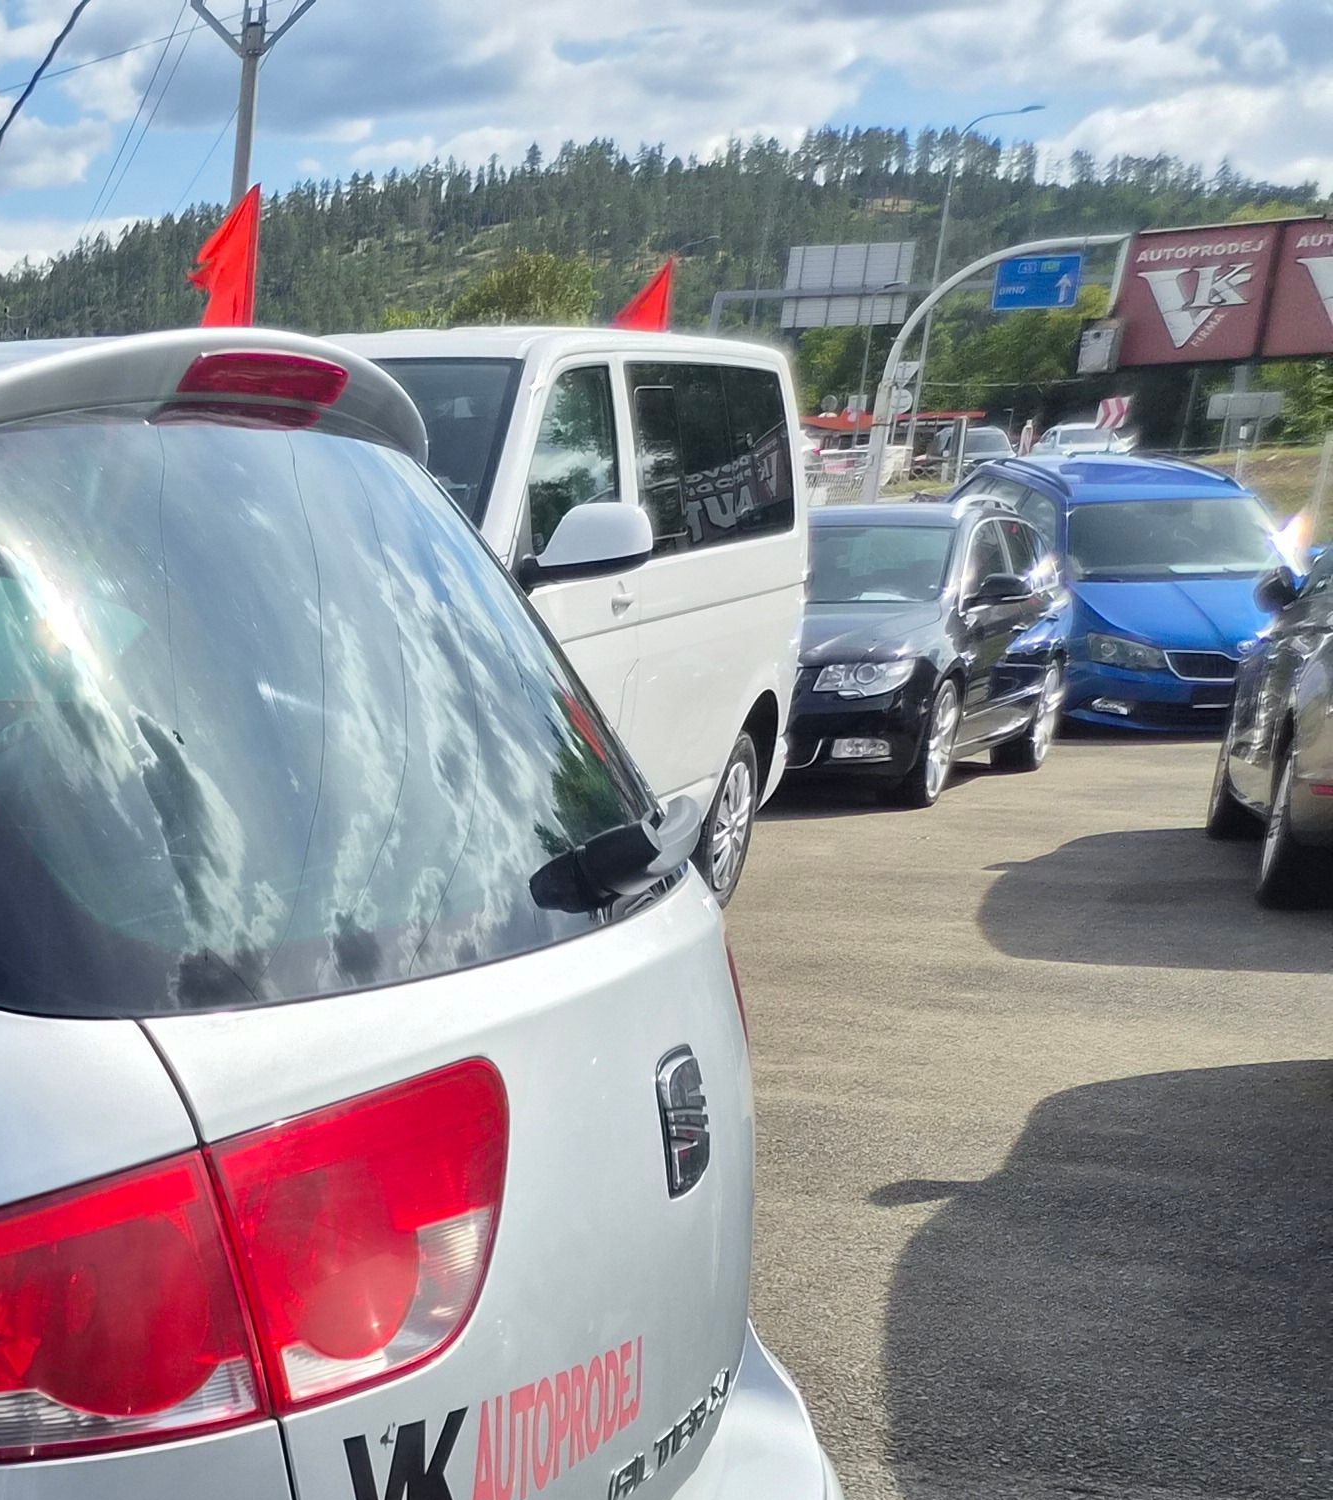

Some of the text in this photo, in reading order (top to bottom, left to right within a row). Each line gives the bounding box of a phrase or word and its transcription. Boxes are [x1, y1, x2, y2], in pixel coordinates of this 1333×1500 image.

[1136, 239, 1264, 263] AUTOPRODEJ
[1137, 262, 1255, 349] VK
[1191, 312, 1226, 348] FIRMA
